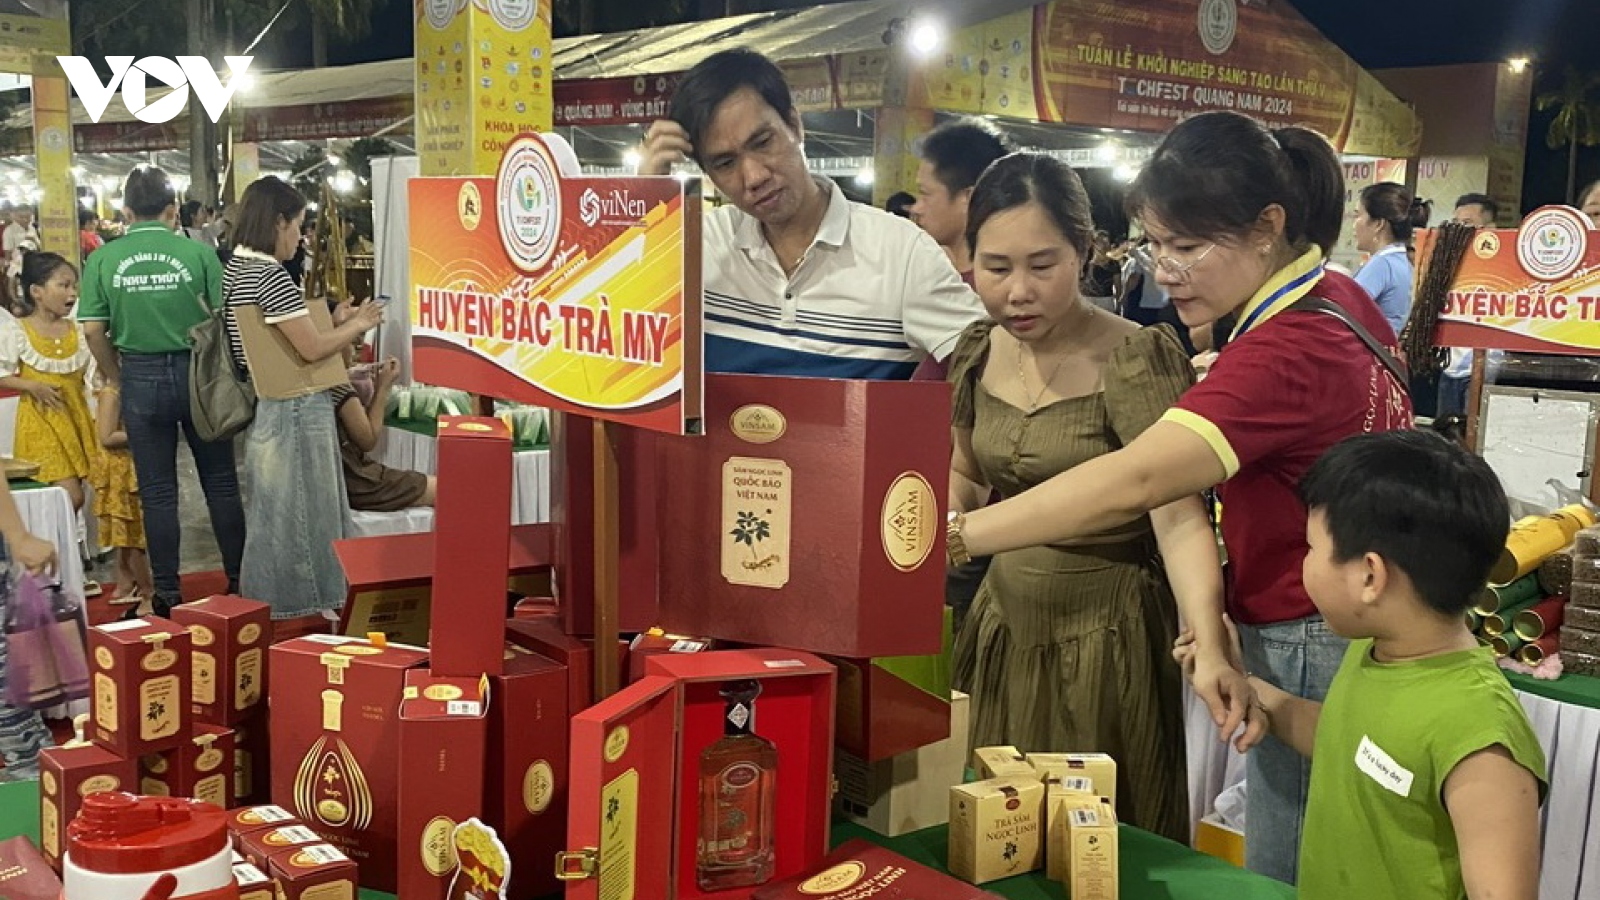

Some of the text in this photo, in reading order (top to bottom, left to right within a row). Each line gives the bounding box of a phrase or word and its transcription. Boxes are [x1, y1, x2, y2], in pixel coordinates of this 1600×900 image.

[1077, 40, 1114, 66] TUẦN
[1115, 44, 1132, 69] LỄ
[1137, 50, 1167, 74] KHỞI
[1170, 58, 1215, 83] NGHIỆP
[1217, 63, 1247, 86] SÁNG
[1250, 70, 1271, 92] TẠO
[1237, 92, 1262, 111] NAM
[1264, 97, 1292, 115] 2024
[485, 120, 514, 133] KHOA
[1344, 164, 1370, 183] TẠO
[1443, 288, 1507, 323] UYỆN
[1514, 284, 1568, 321] BẮC
[418, 280, 670, 364] HUYỆN BẮC TRÀ MY
[741, 421, 775, 431] VINSAM
[733, 475, 782, 489] QUỐC BẢO
[736, 489, 778, 501] VIỆT NAM
[905, 490, 919, 552] VINSAM
[1016, 822, 1037, 835] LINH
[438, 826, 447, 865] VINSAM
